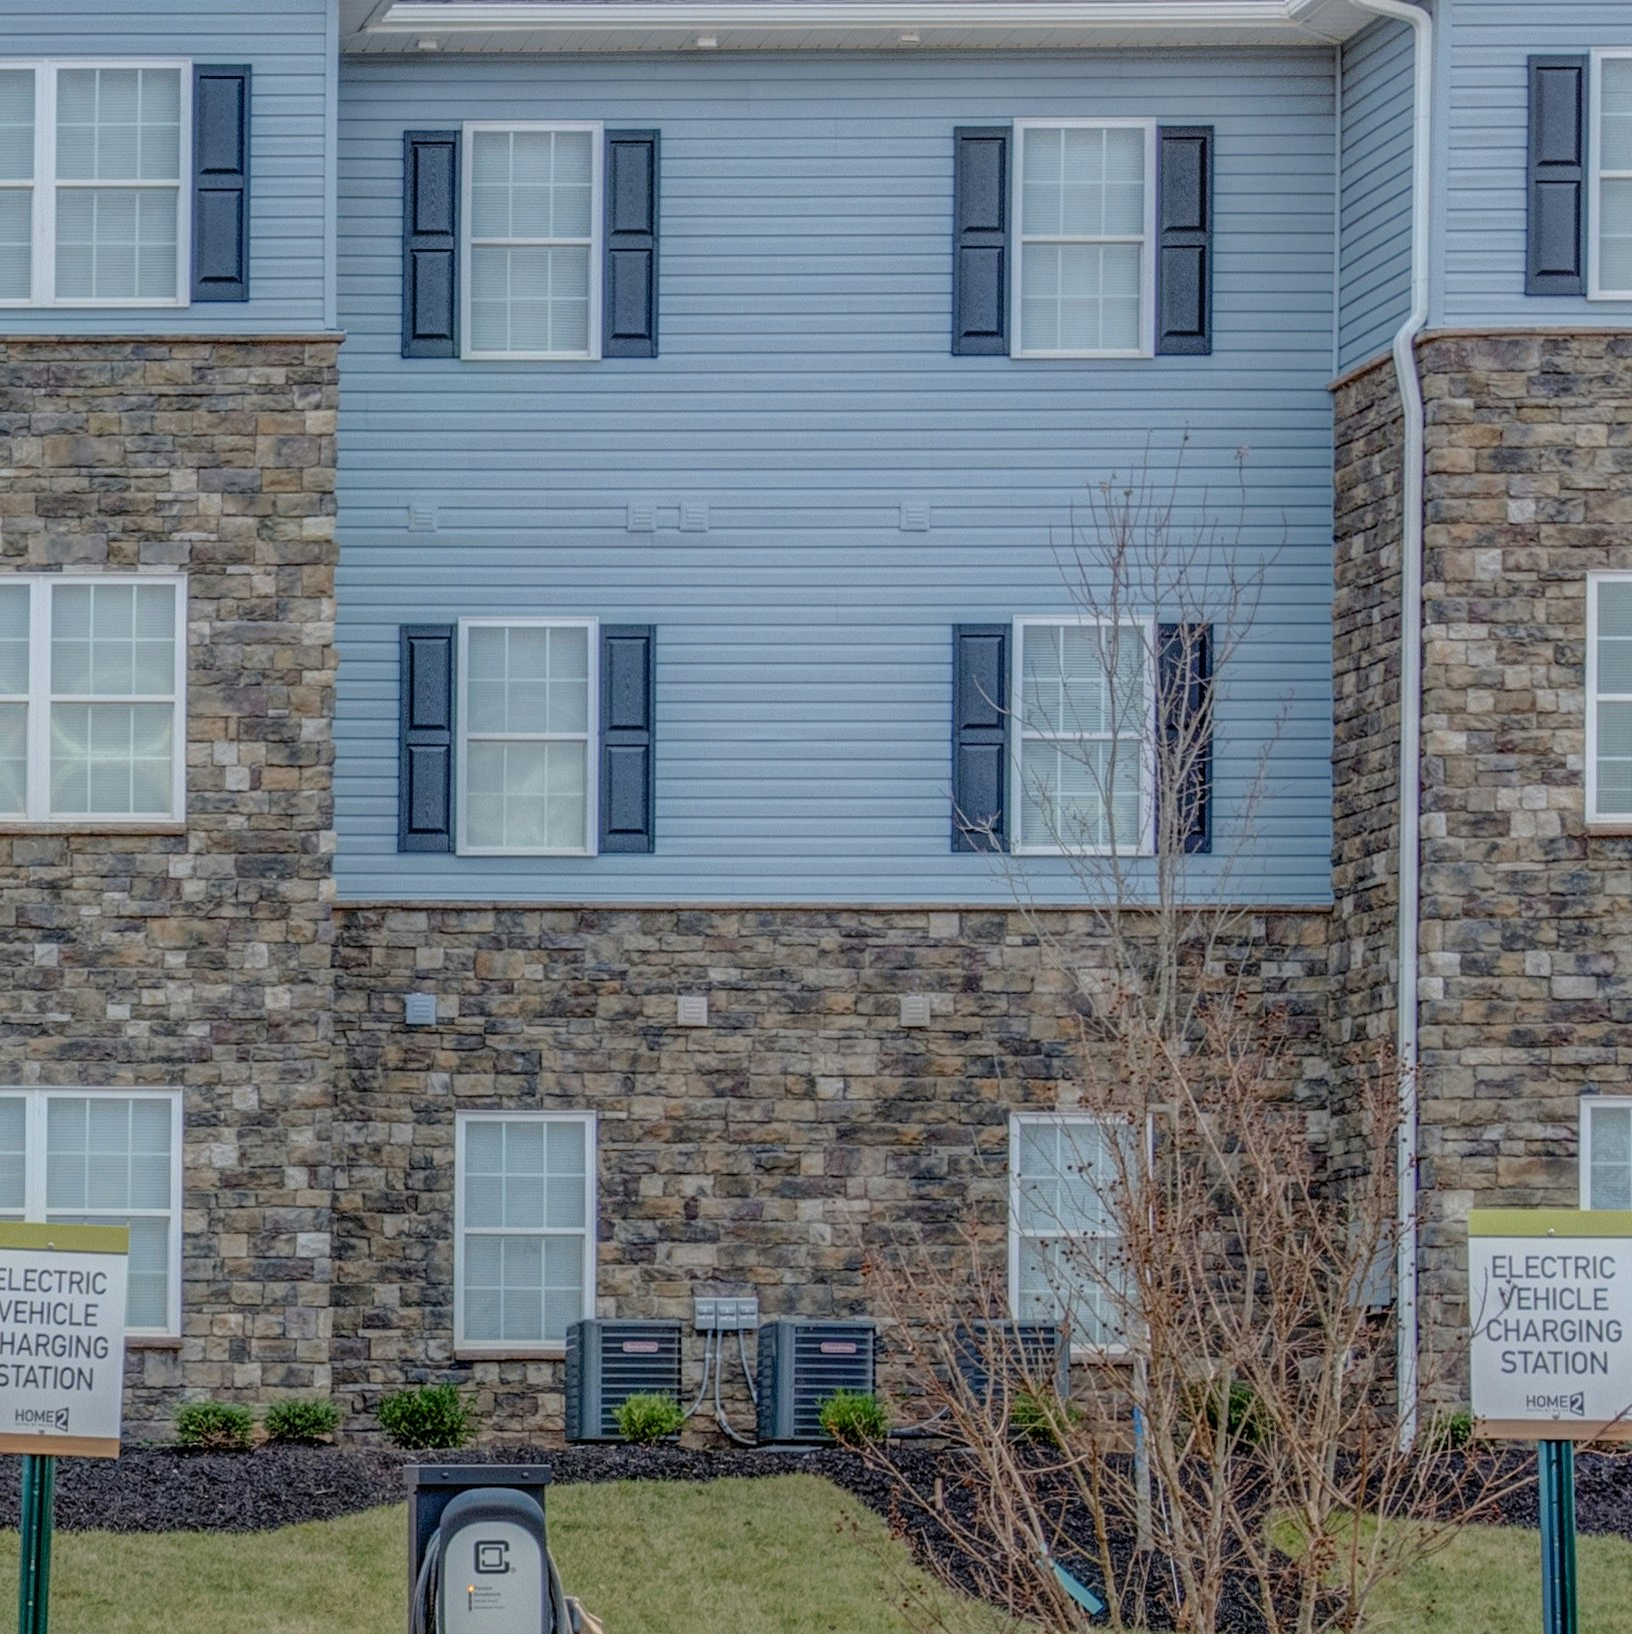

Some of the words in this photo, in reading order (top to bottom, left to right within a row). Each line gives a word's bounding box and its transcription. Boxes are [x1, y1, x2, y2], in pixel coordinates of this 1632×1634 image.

[1492, 1255, 1616, 1279] ELECTRIC
[1498, 1287, 1609, 1311] VEHICLE
[1486, 1318, 1623, 1343] CHARGING
[1501, 1351, 1609, 1375] STATION
